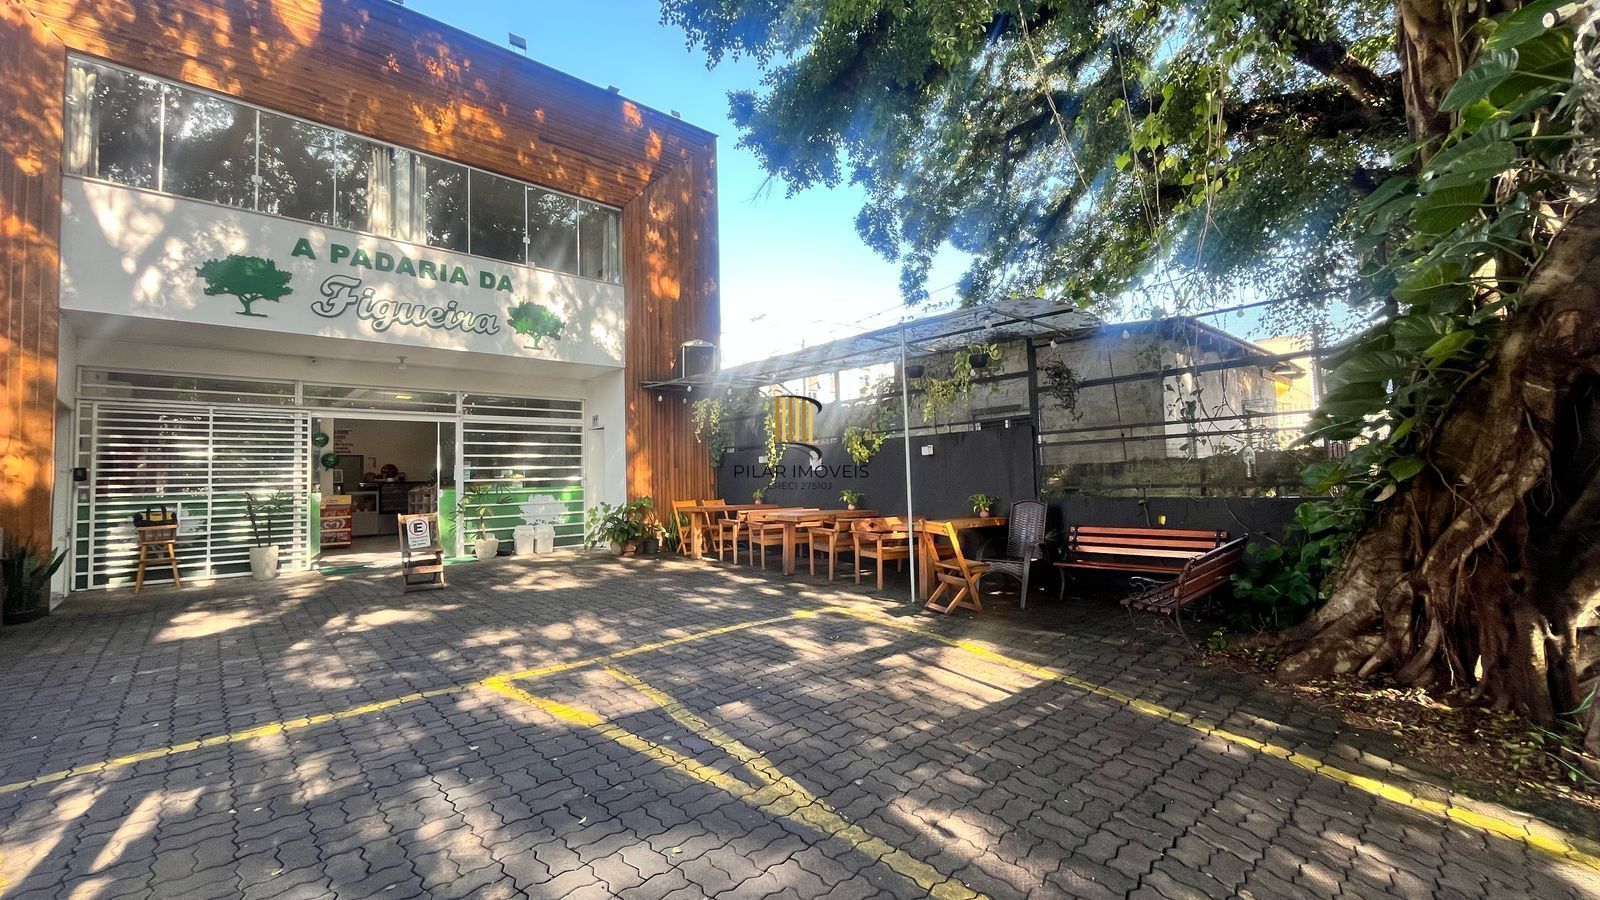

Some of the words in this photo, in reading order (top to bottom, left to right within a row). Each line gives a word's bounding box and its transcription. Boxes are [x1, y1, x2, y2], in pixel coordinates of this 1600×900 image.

[291, 237, 317, 261] A
[329, 243, 470, 286] PADARIA
[479, 270, 515, 293] DA
[311, 274, 501, 336] Figueira
[413, 522, 424, 533] E
